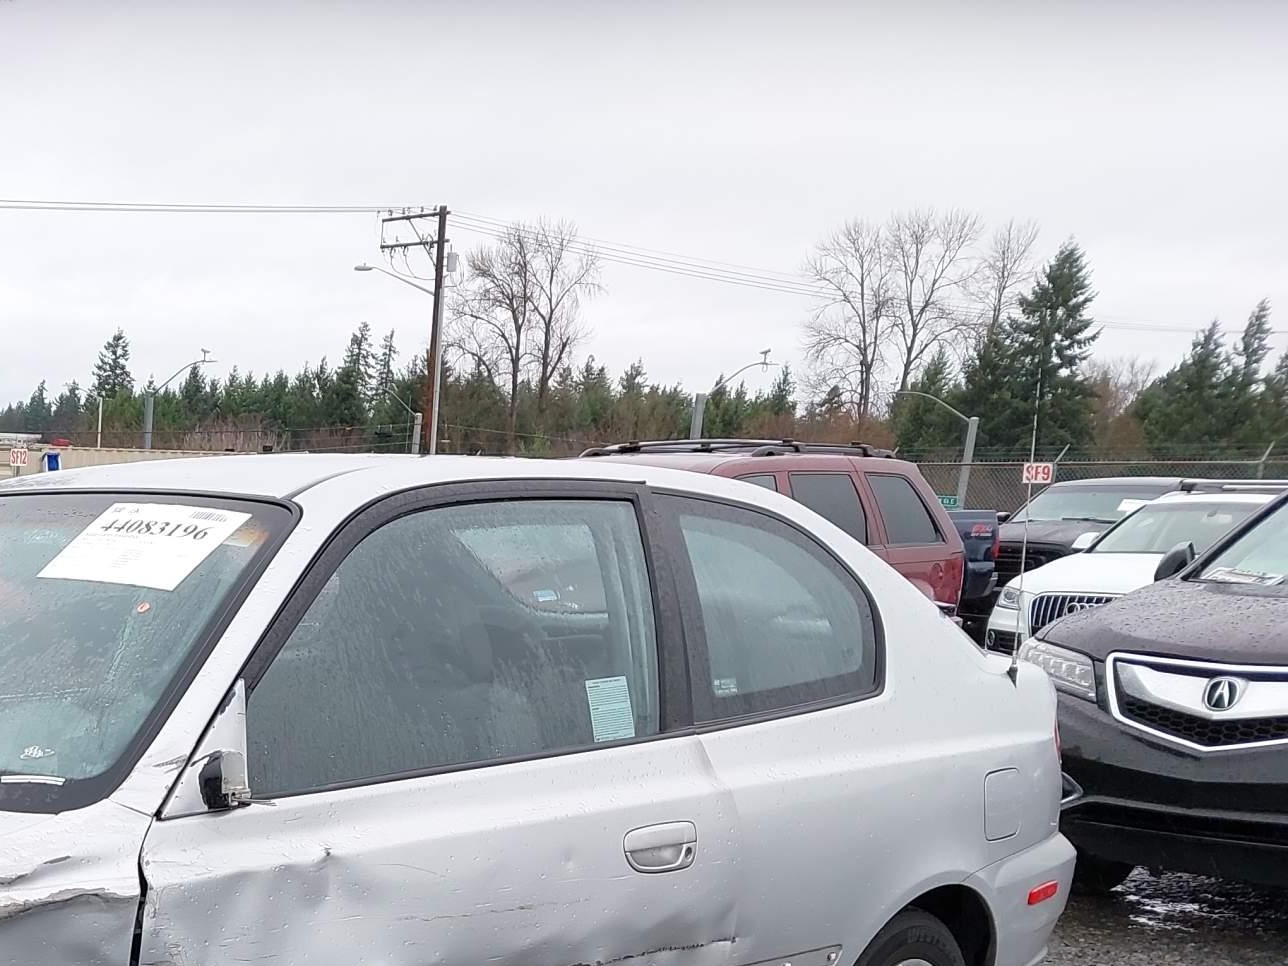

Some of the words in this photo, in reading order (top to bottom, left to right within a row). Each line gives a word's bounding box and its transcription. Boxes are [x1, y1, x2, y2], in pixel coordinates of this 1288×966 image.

[11, 450, 27, 465] SF12
[1025, 465, 1051, 481] SF9
[100, 518, 214, 541] 44083196
